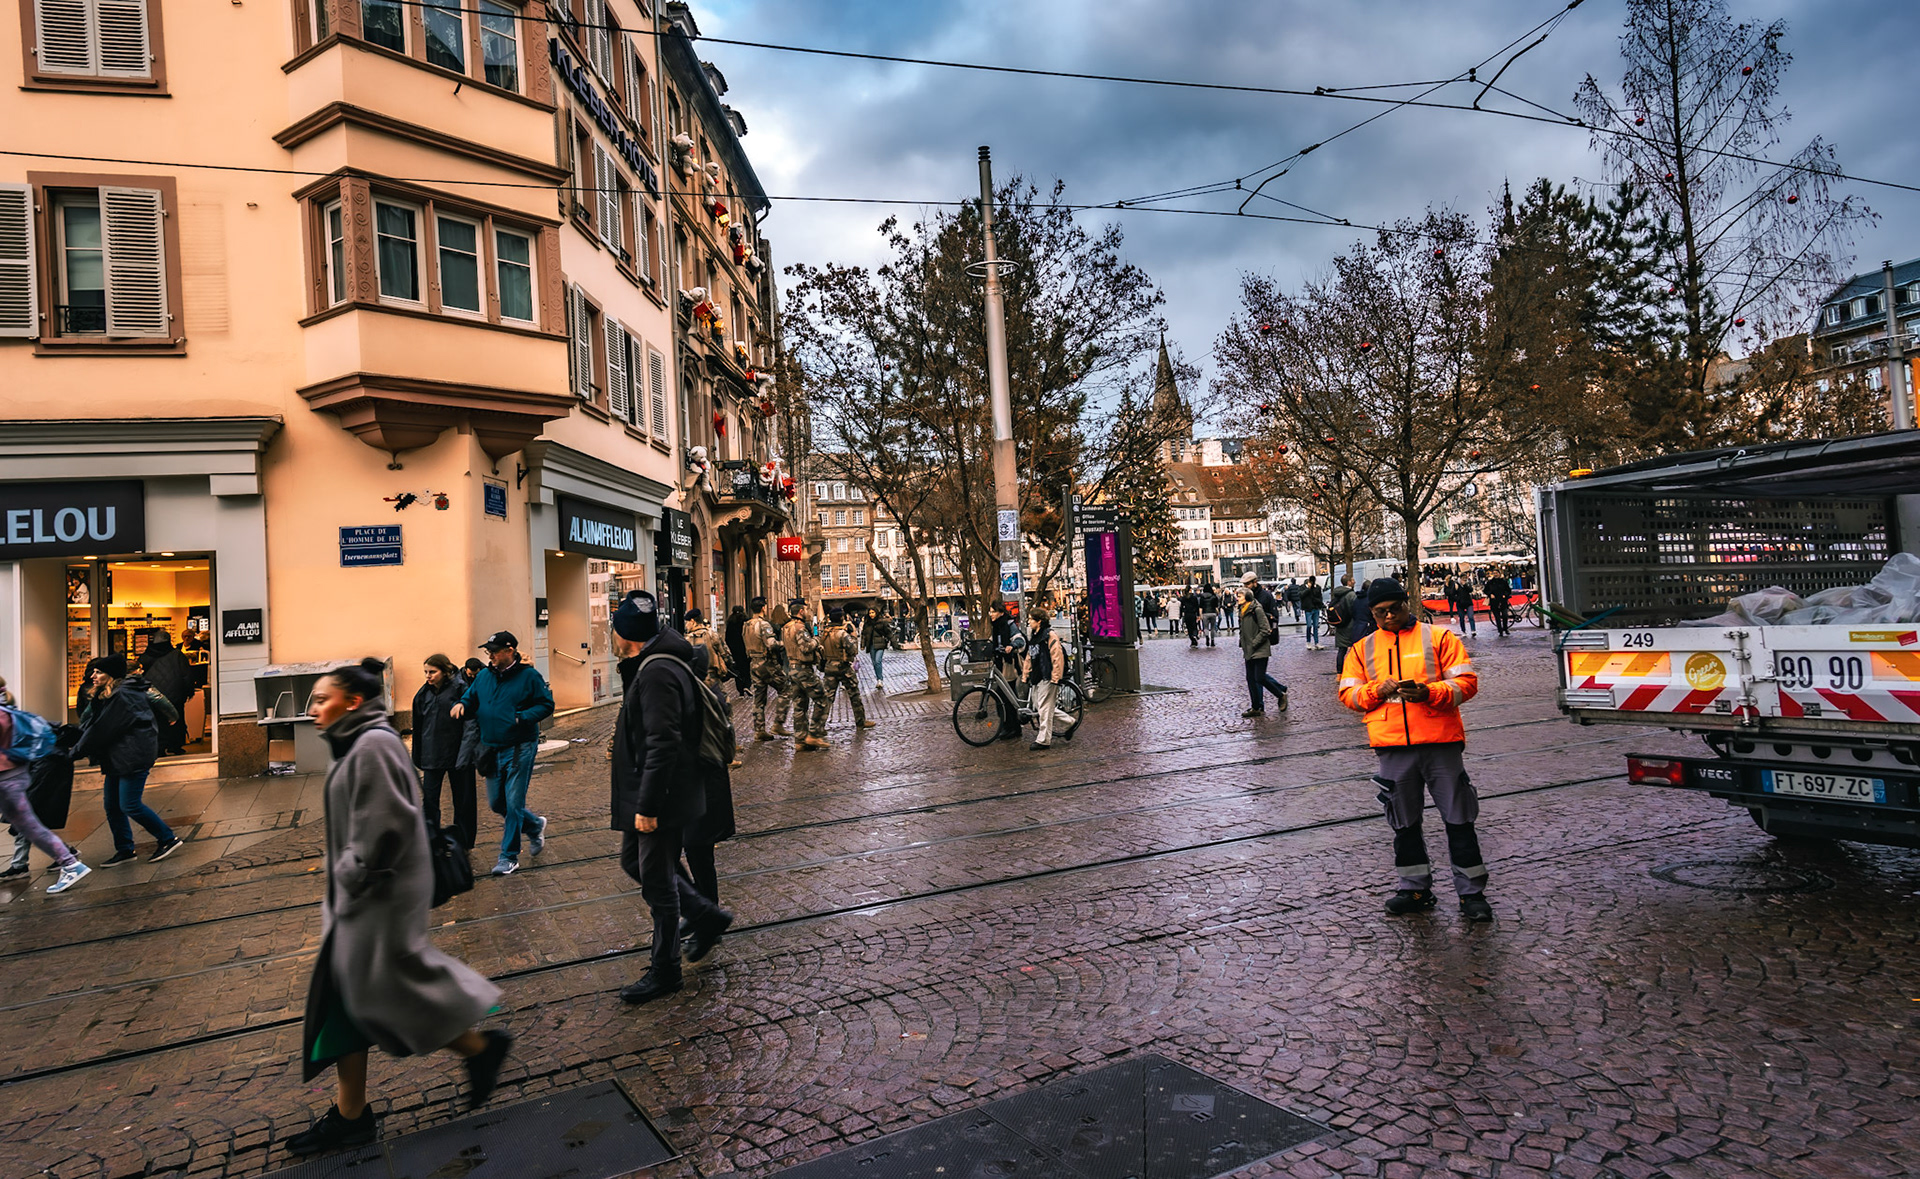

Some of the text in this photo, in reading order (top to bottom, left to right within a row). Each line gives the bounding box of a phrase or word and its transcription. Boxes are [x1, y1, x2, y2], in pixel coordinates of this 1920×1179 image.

[0, 506, 116, 545] ELOU
[677, 519, 684, 529] LE
[670, 531, 692, 547] KLÉBER
[781, 544, 800, 554] SFR
[225, 629, 260, 638] AFFLELOU
[237, 622, 259, 630] ALAIN
[1622, 632, 1654, 648] 249
[1780, 656, 1863, 690] 80 90
[1775, 772, 1871, 797] FT-697-ZC
